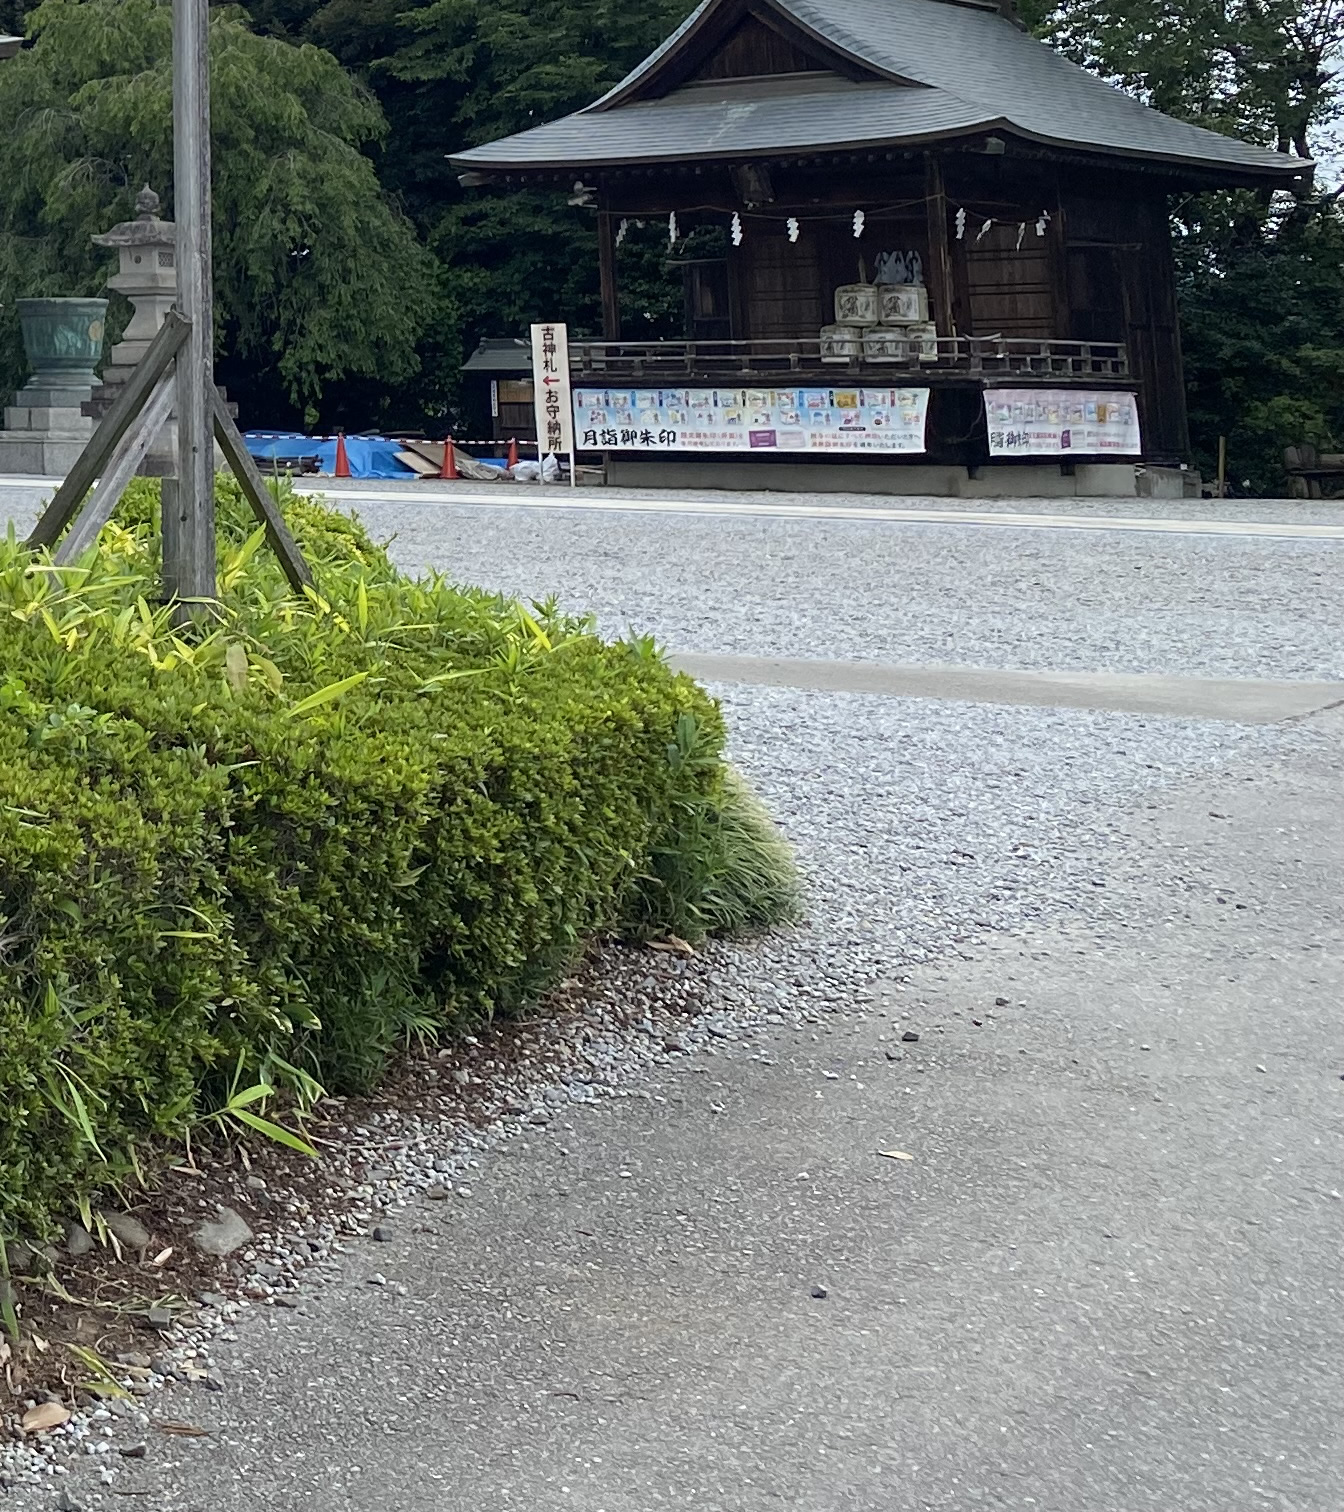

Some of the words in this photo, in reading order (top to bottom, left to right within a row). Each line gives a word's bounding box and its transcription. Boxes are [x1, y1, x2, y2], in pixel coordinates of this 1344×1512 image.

[541, 326, 558, 373] 古神札
[545, 389, 563, 451] お守納所
[582, 428, 677, 447] 月詣御朱印
